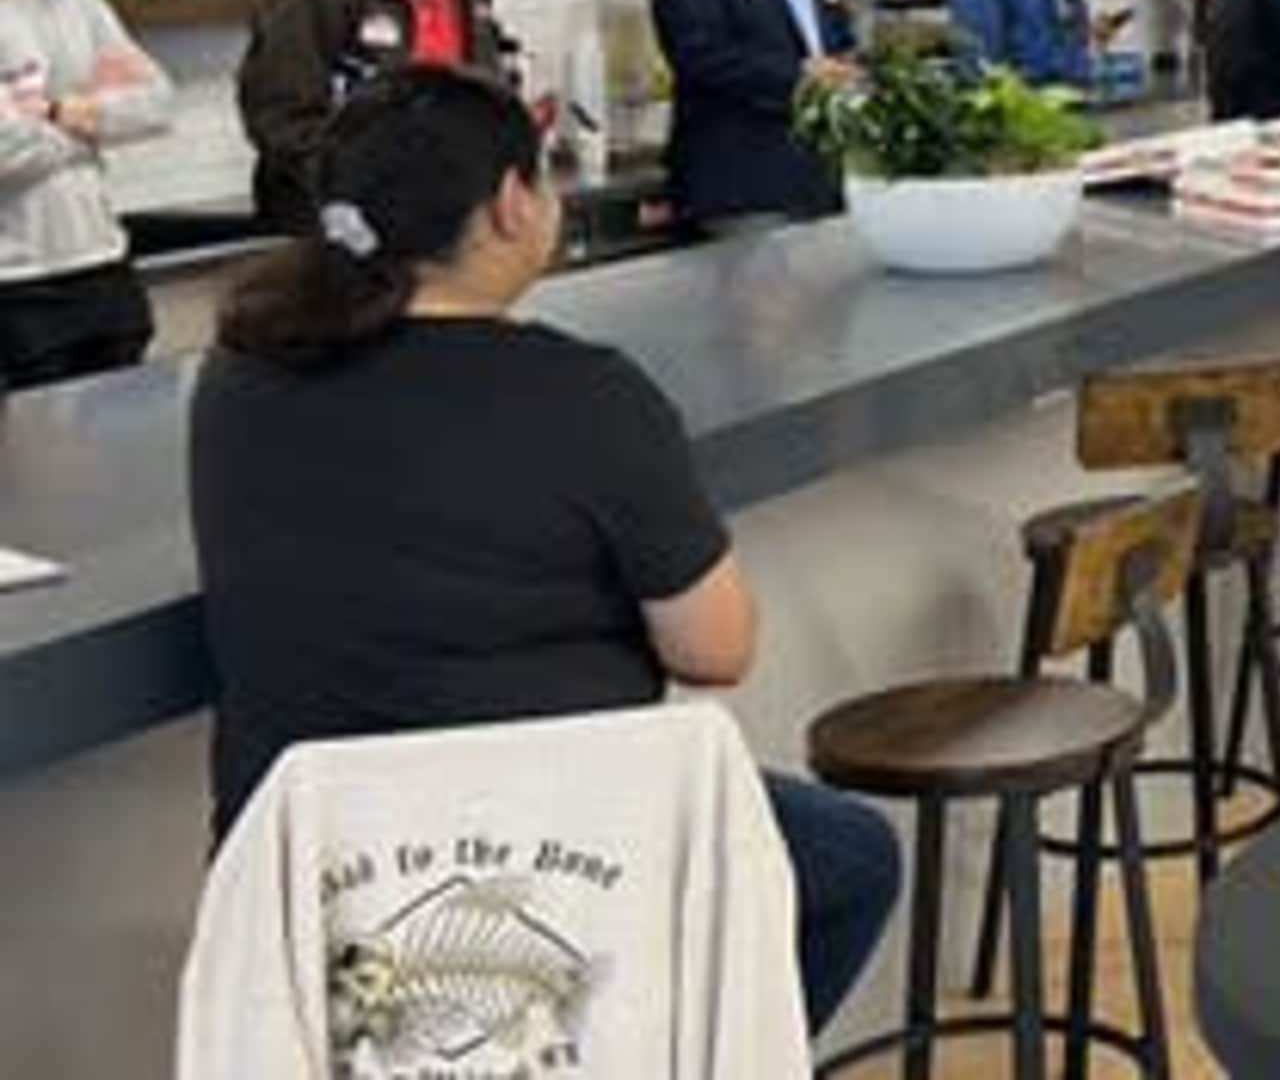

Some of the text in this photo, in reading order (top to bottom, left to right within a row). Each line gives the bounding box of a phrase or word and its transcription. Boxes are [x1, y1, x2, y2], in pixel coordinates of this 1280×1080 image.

[396, 844, 432, 875] to
[454, 837, 511, 868] the
[534, 838, 622, 890] Bone
